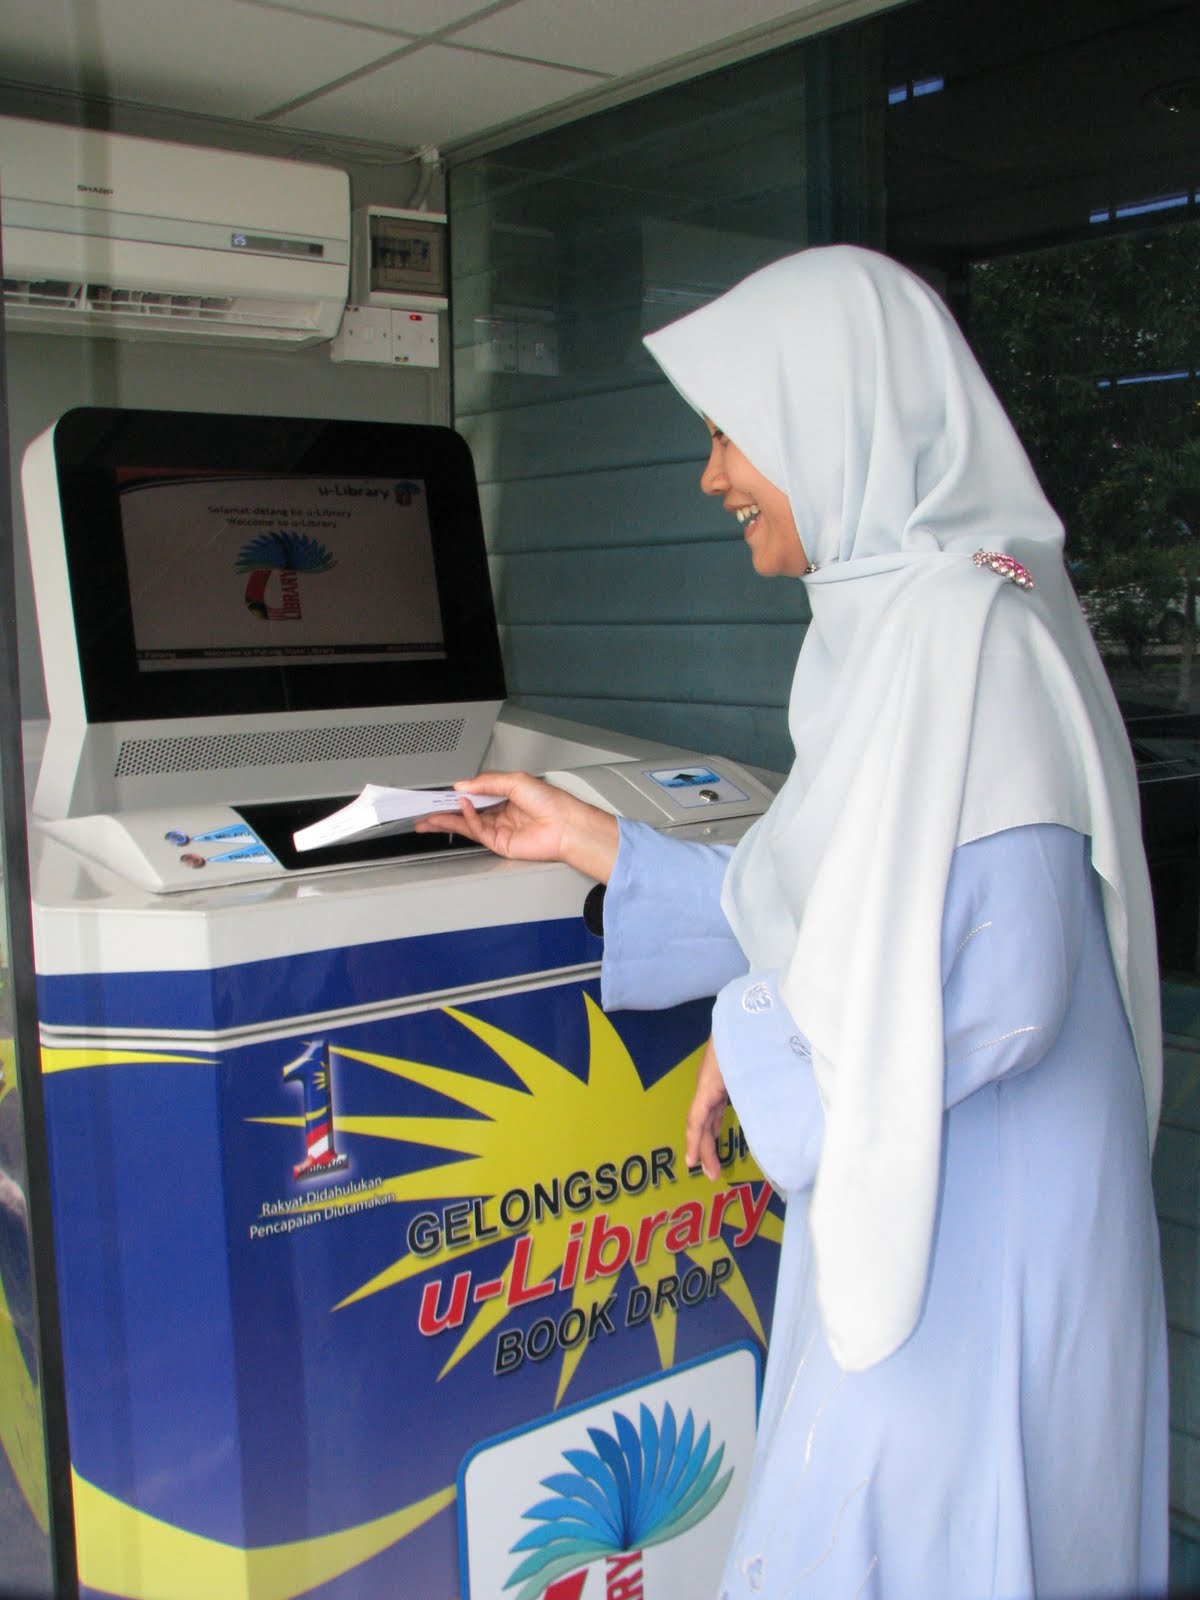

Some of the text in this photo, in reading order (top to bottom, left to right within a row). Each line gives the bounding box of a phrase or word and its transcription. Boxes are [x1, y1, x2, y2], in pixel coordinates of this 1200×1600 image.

[77, 184, 115, 195] SHARP
[207, 505, 249, 516] Selamat
[252, 507, 288, 518] datang
[305, 508, 352, 519] u-Library
[318, 483, 389, 500] u-Library
[227, 518, 274, 527] Welcome
[291, 518, 337, 528] u-Library
[279, 570, 301, 620] LIBRARY
[249, 1191, 396, 1240] Pencapaian Diutamakan
[261, 1175, 383, 1217] Rakyat Didahulukan
[406, 1145, 677, 1258] GELONGSOR
[418, 1180, 773, 1337] u-Library
[494, 1256, 733, 1376] BOOK DROP
